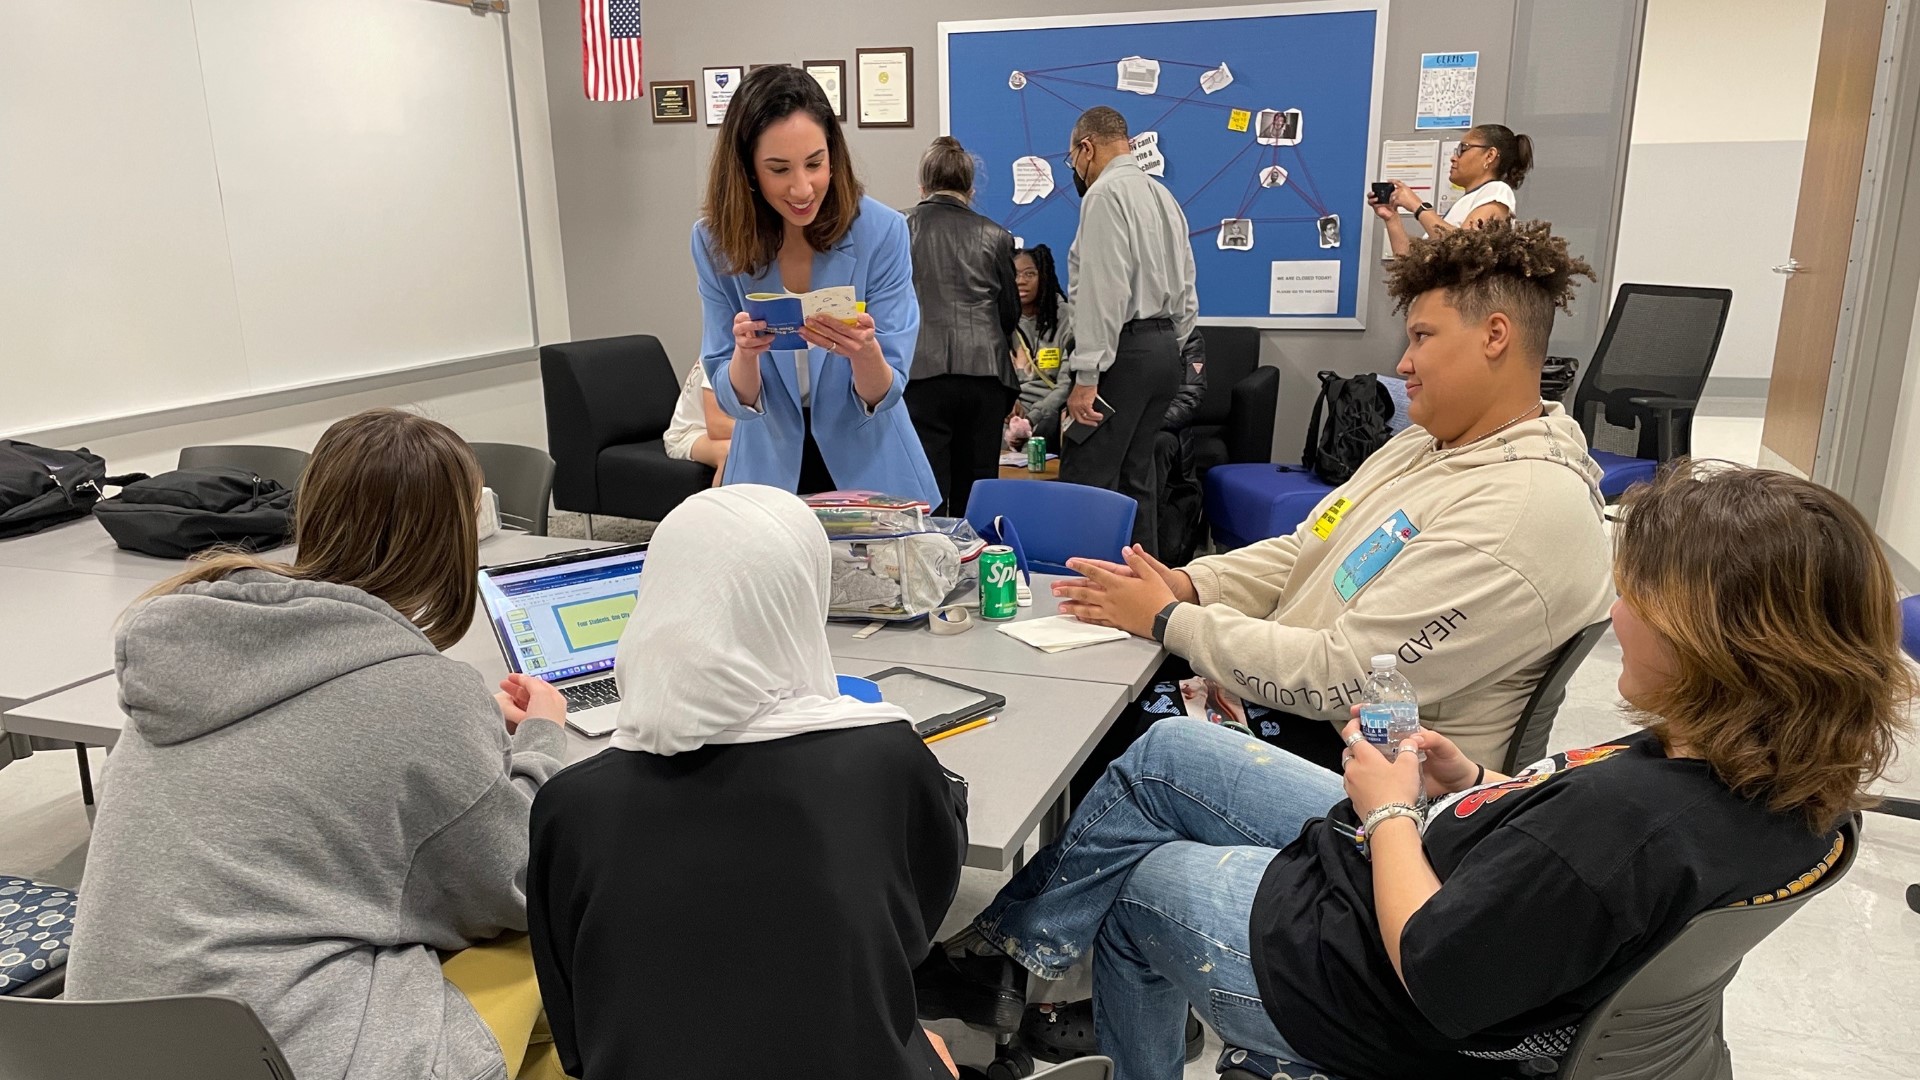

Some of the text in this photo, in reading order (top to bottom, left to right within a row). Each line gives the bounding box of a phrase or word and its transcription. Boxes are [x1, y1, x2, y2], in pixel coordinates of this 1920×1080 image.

[1136, 152, 1148, 161] rite
[1141, 160, 1160, 172] chline
[1233, 608, 1467, 711] HEAD HE CLOUDS
